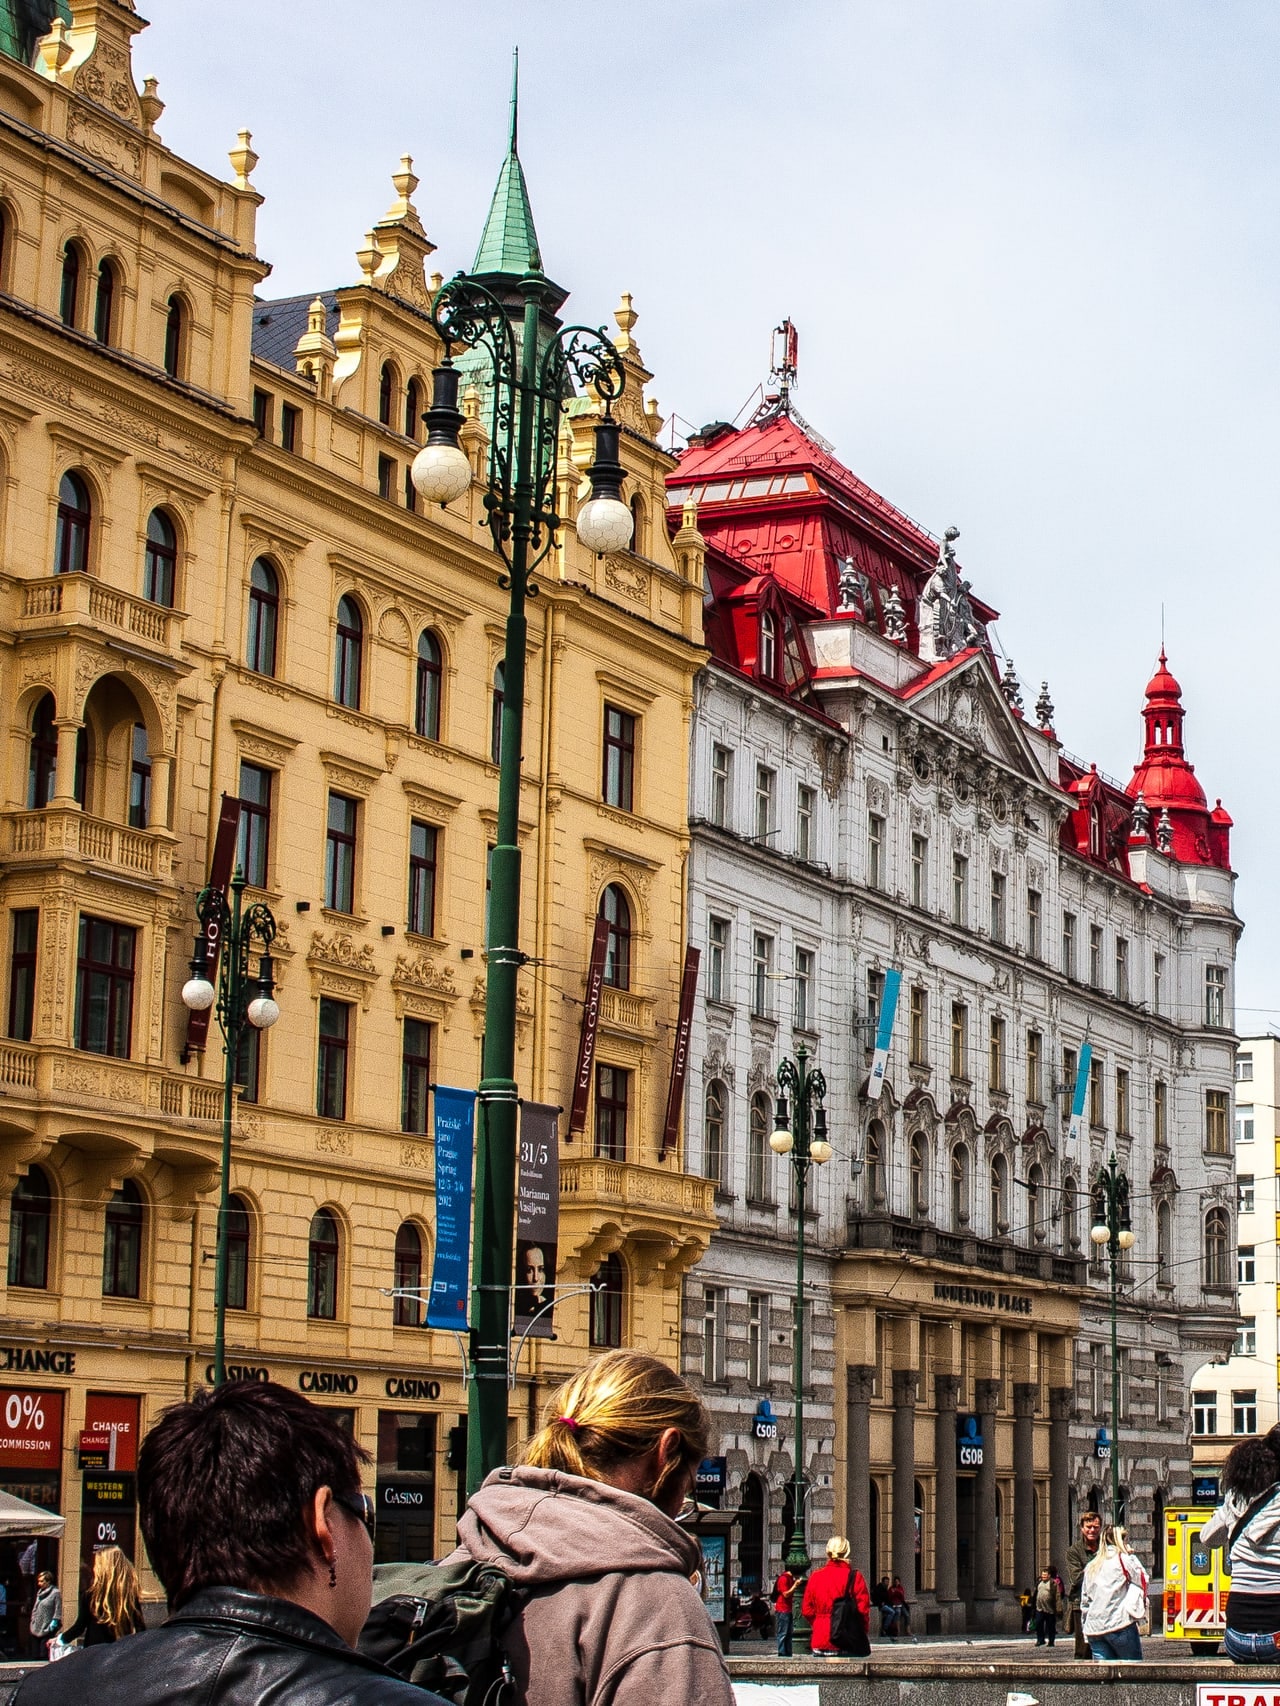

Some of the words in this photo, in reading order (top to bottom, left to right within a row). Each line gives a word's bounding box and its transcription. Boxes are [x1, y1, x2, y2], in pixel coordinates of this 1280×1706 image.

[206, 883, 226, 958] HOL
[579, 1030, 594, 1089] KINGS
[588, 969, 602, 1028] COURT
[676, 1017, 690, 1077] HOTEL
[437, 1145, 458, 1160] Prague
[521, 1141, 548, 1169] 31/5
[437, 1162, 457, 1176] Spring
[519, 1186, 550, 1200] Marianna
[0, 1349, 76, 1374] CHANGE
[299, 1371, 358, 1394] CASINO
[386, 1378, 441, 1400] CASINO
[6, 1394, 45, 1430] 0%
[92, 1421, 130, 1433] CHANGE
[756, 1423, 777, 1438] ČSOB
[0, 1438, 51, 1450] COMMISSION
[82, 1436, 110, 1444] CHANGE
[960, 1445, 983, 1465] ČSOB
[87, 1482, 123, 1491] WESTERN
[98, 1491, 123, 1499] UNION
[98, 1522, 117, 1541] 0%
